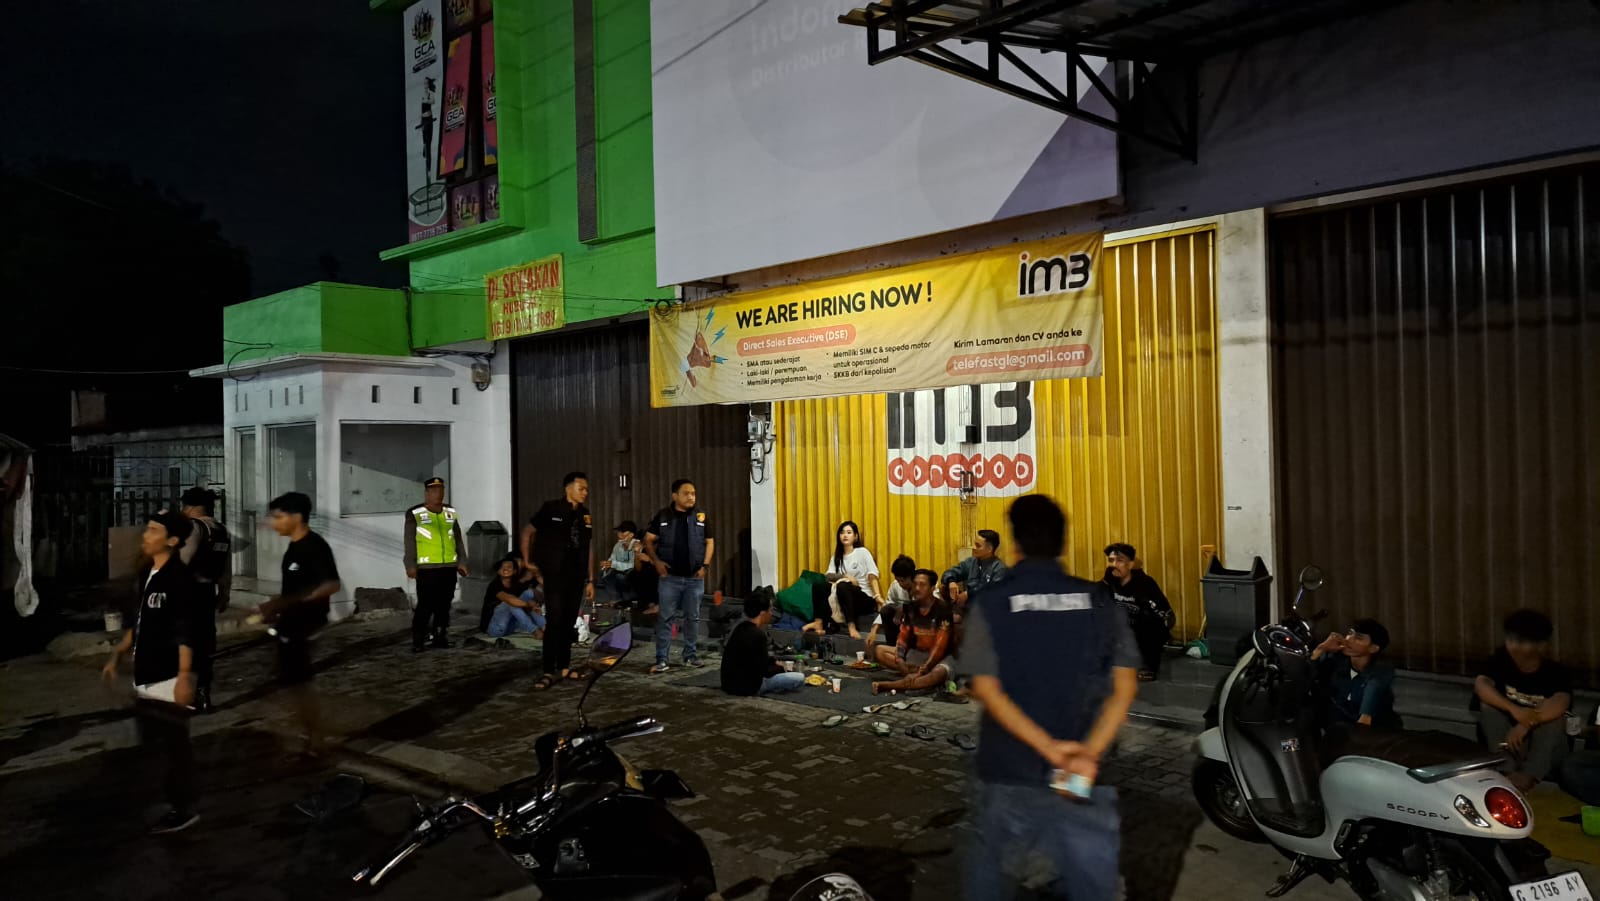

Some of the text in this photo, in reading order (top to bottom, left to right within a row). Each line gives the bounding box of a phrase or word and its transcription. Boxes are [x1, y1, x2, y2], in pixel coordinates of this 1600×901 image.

[414, 40, 436, 59] GCA
[487, 276, 499, 304] DI
[735, 308, 763, 329] WE
[765, 302, 799, 326] ARE
[802, 292, 866, 320] HIRING
[870, 282, 923, 310] NOW
[743, 329, 848, 351] Direct Sales Executive (DSE)
[953, 328, 1083, 349] Kirim Lamaran dan CV anda ke
[833, 348, 859, 358] Memiliki
[859, 347, 872, 355] SIM
[872, 346, 878, 354] C
[884, 342, 910, 353] sepeda
[910, 341, 931, 350] motor
[953, 349, 1086, 370] telefastgl@gmail.com
[760, 359, 773, 367] atau
[773, 356, 801, 365] sederajat
[833, 356, 889, 368] untuk operasional
[850, 369, 864, 377] dari
[864, 366, 897, 376] kepolisian
[746, 373, 822, 386] Memiliki pengalaman kerja
[888, 453, 1034, 489] ooredoo
[1386, 802, 1451, 820] SCOOPY
[1530, 881, 1560, 900] 2196
[1564, 875, 1581, 893] AY
